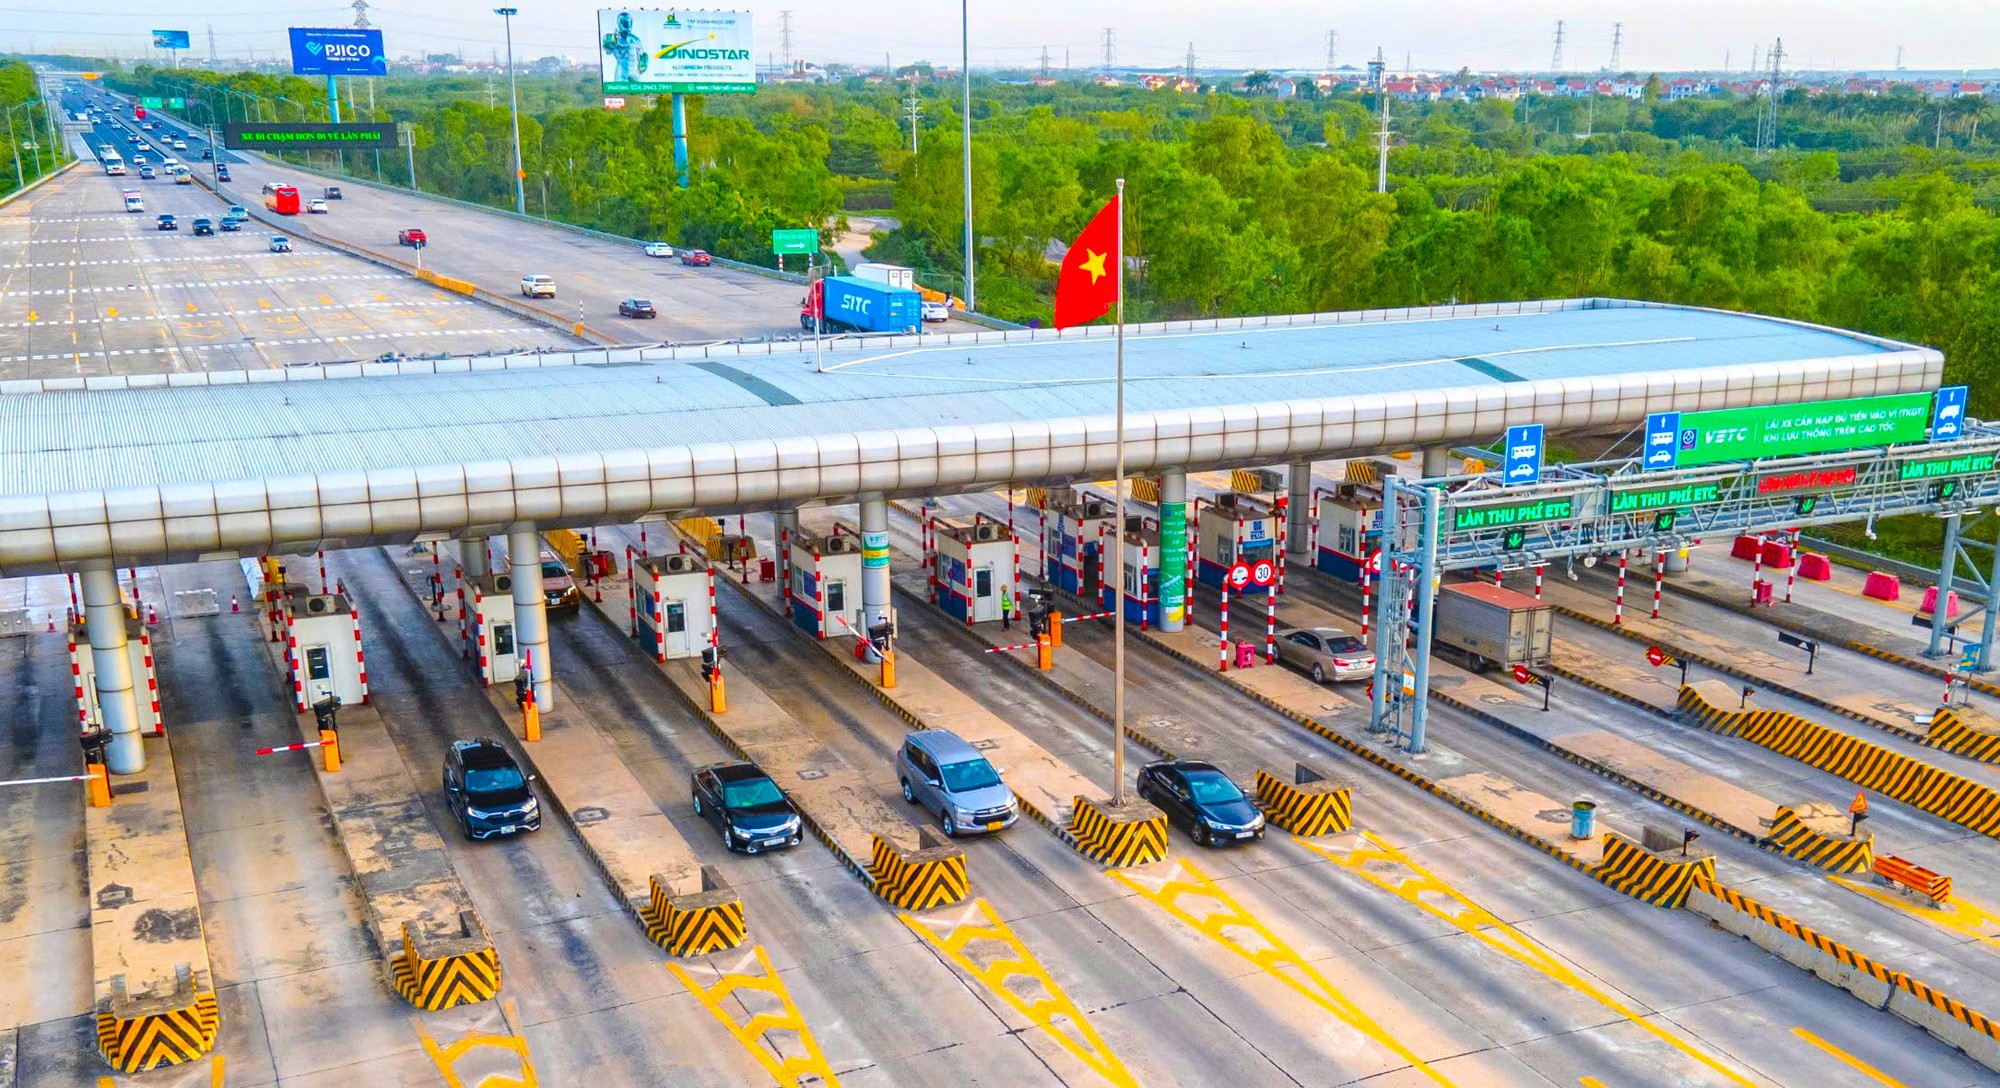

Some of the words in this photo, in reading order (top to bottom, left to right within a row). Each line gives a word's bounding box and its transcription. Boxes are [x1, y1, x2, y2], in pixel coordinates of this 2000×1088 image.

[324, 44, 371, 57] PJICO
[659, 44, 749, 60] DINOSTAR
[241, 132, 253, 141] XE
[841, 294, 872, 315] SITC
[1781, 418, 1792, 429] XE
[1705, 427, 1748, 445] VETC
[1763, 432, 1779, 443] KHI
[1801, 427, 1832, 440] THÔNG
[1834, 425, 1856, 436] TRÊN
[1858, 423, 1876, 434] CAO
[1902, 460, 1925, 479] LÀN
[1925, 461, 1949, 476] THU
[1949, 454, 1972, 473] PHÍ
[1972, 456, 1993, 470] ETC
[1612, 492, 1638, 511] LÀN
[1640, 490, 1667, 507] THU
[1668, 484, 1692, 504] PHÍ
[1693, 485, 1717, 501] ETC
[1457, 508, 1485, 528] LÀN
[1487, 508, 1515, 524] THU
[1517, 501, 1543, 521] PHÍ
[1545, 502, 1570, 518] ETC
[1257, 566, 1269, 579] 30
